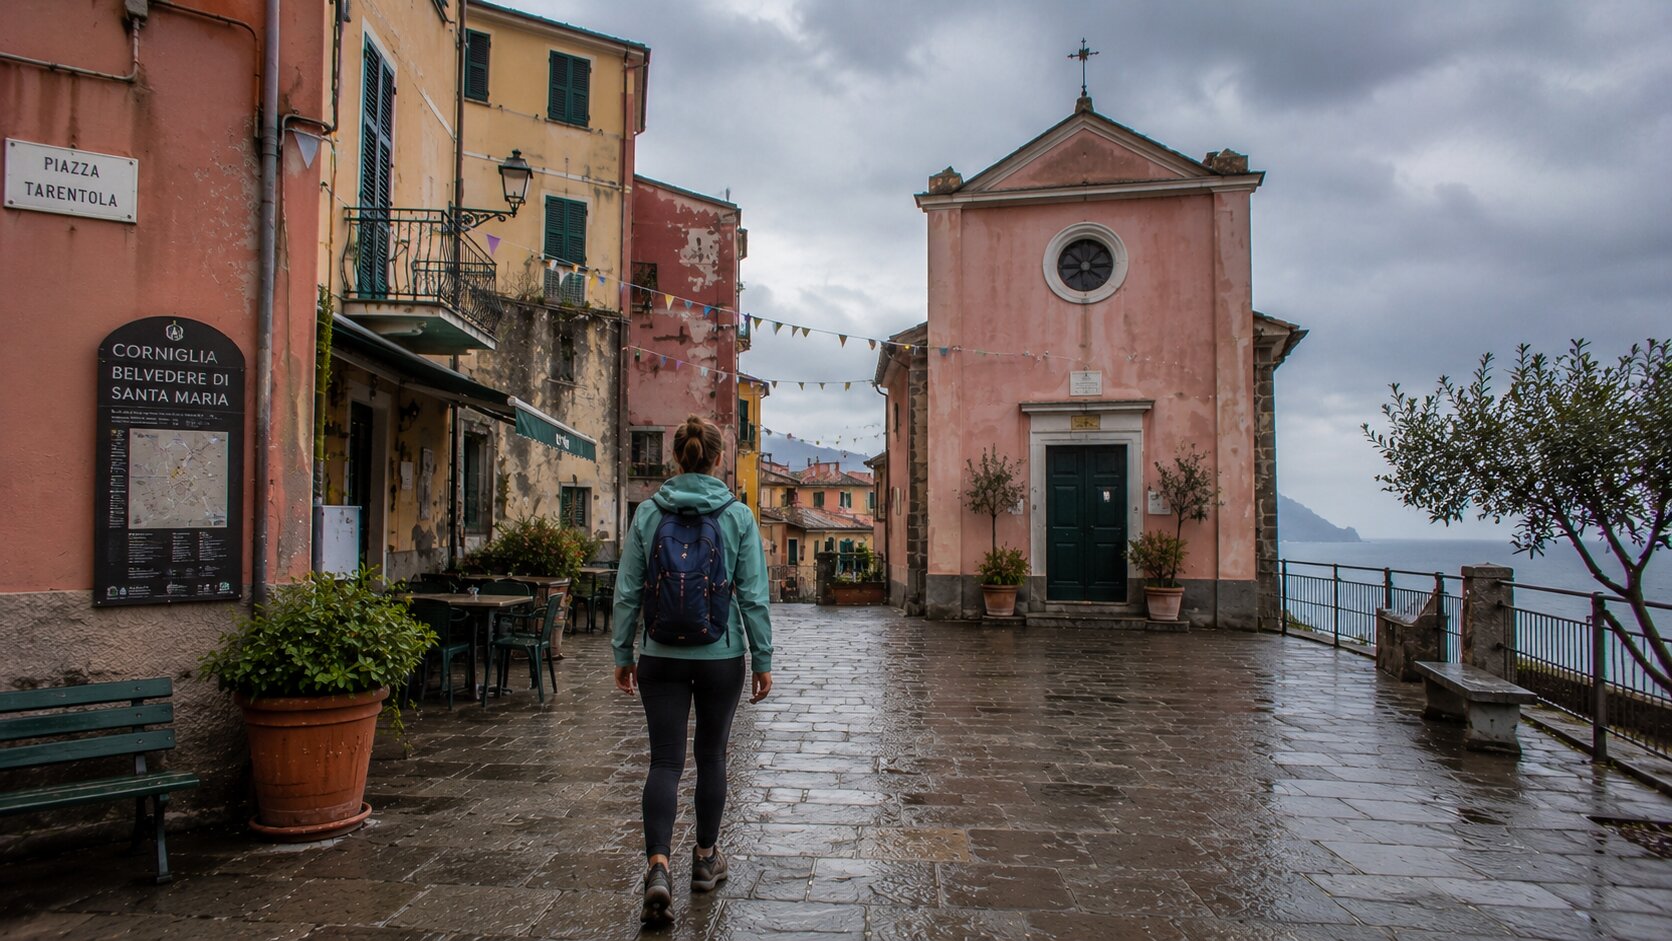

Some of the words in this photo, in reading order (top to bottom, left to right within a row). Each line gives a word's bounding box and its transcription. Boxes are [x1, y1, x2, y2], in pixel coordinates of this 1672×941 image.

[44, 156, 100, 178] PIAZZA
[25, 181, 118, 208] TARENTOLA
[112, 343, 218, 364] CORNIGLIA
[112, 366, 207, 385] BELVEDERE
[213, 373, 229, 387] DI
[111, 387, 169, 403] SANTA
[175, 390, 229, 406] MARIA
